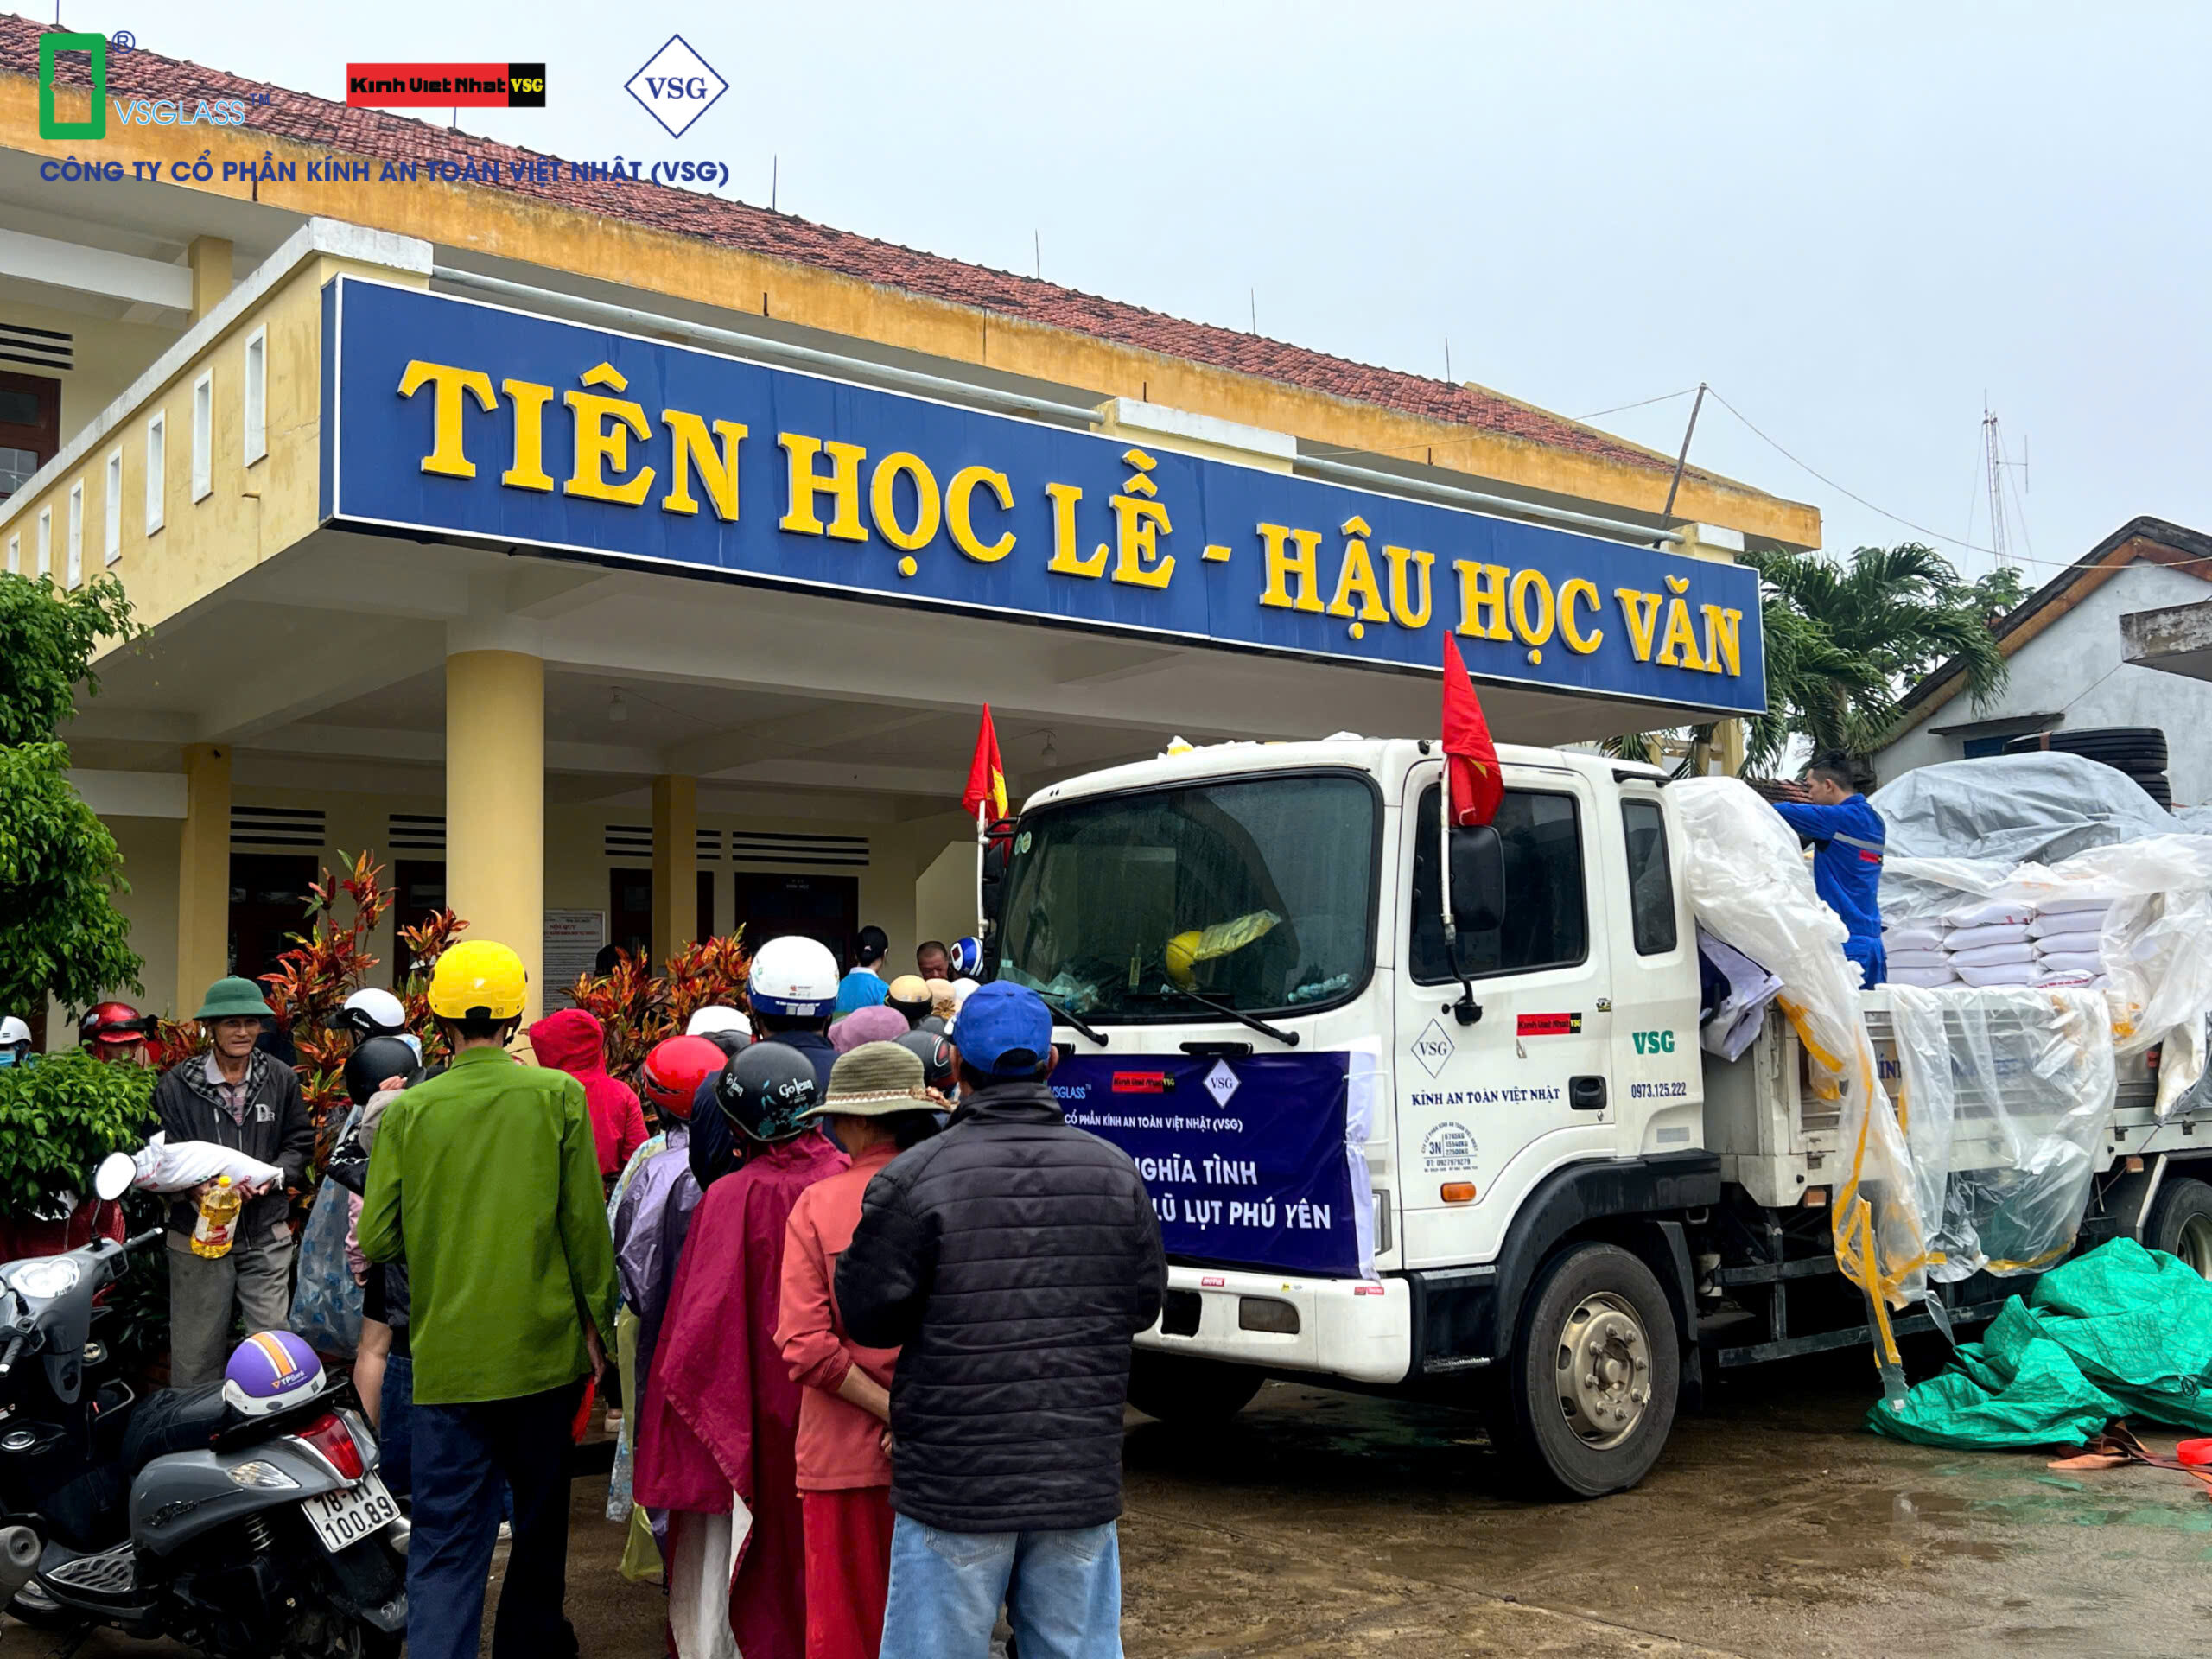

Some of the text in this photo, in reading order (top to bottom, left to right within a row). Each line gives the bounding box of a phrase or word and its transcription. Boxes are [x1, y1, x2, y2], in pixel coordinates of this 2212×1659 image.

[396, 359, 749, 523] TIÊN
[777, 431, 1018, 578] HỌC
[1045, 448, 1176, 590] LỄ
[1255, 514, 1436, 641] HẬU
[1452, 558, 1604, 666] HỌC
[1613, 573, 1744, 677] VĂN
[1419, 1041, 1447, 1056] VSG
[1631, 1029, 1675, 1055] VSG
[1211, 1077, 1233, 1089] VSG
[1411, 1084, 1560, 1106] KÍNH AN TOÀN VIỆT NHẬT
[1630, 1081, 1687, 1098] 0973.125.222
[1064, 1109, 1078, 1124] CỔ
[1103, 1112, 1122, 1127] KÍNH
[1122, 1116, 1136, 1128] AN
[1137, 1114, 1164, 1128] TOÀN
[1165, 1114, 1184, 1132] VIỆT
[1185, 1115, 1211, 1133] NHẬT
[1212, 1117, 1243, 1134] (VSG)
[1429, 1141, 1442, 1155] 3N
[1203, 1153, 1258, 1185] TÌNH
[1184, 1199, 1223, 1230] LỤT
[1229, 1195, 1276, 1228] PHÚ
[1285, 1197, 1332, 1230] YÊN
[325, 1496, 395, 1545] 100.89
